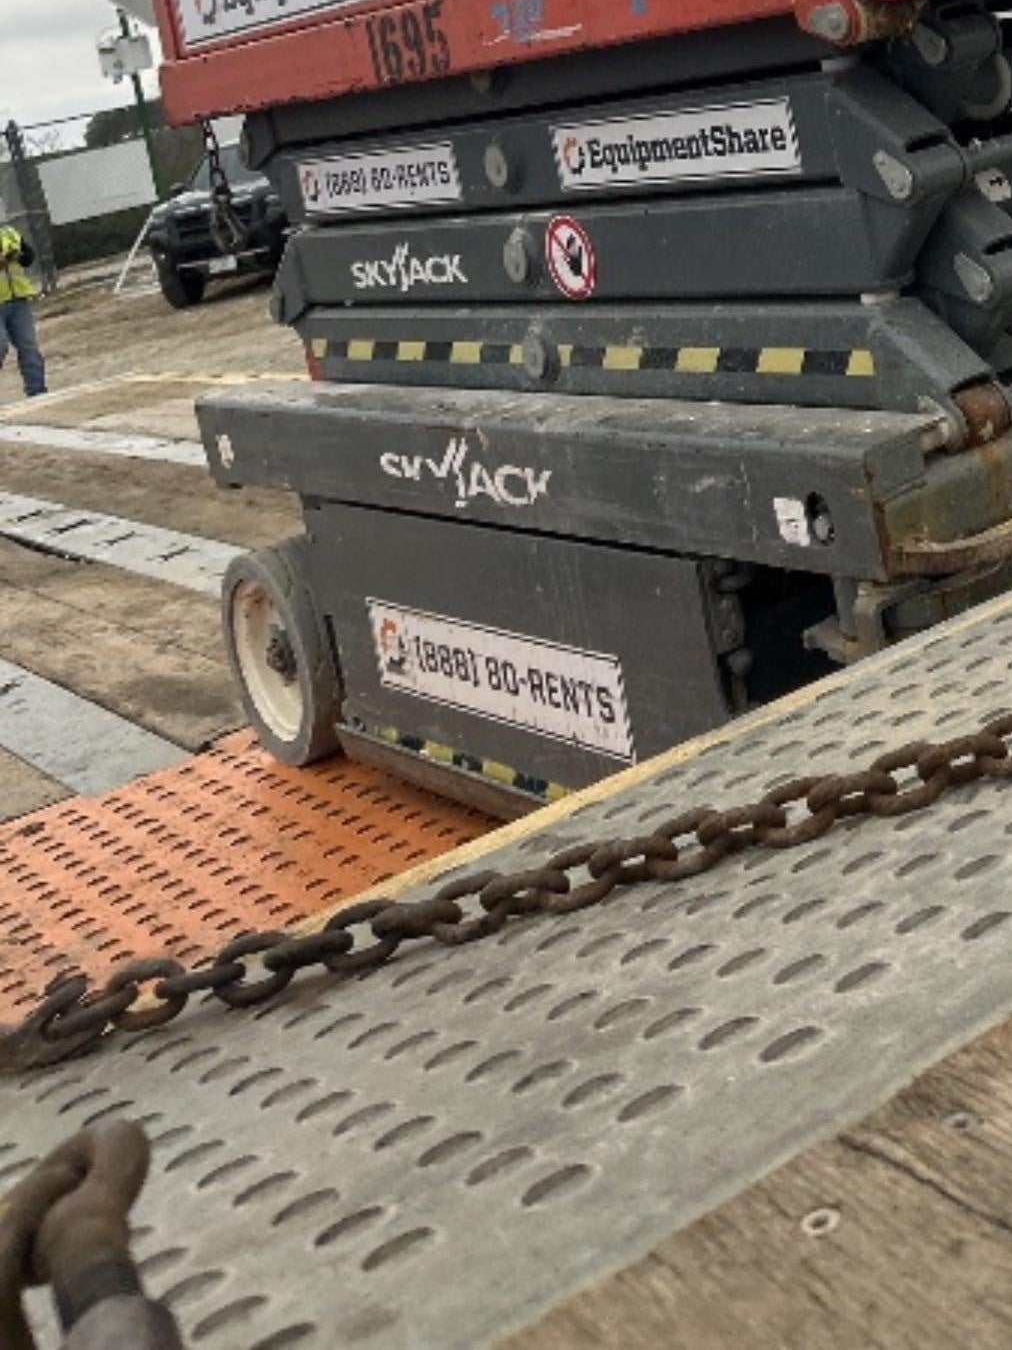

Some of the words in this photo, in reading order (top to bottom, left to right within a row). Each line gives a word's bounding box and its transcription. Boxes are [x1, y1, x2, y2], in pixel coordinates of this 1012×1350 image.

[586, 123, 787, 174] EquipmentShare
[415, 635, 480, 688] (888)
[485, 656, 616, 724] 80-RENTS
